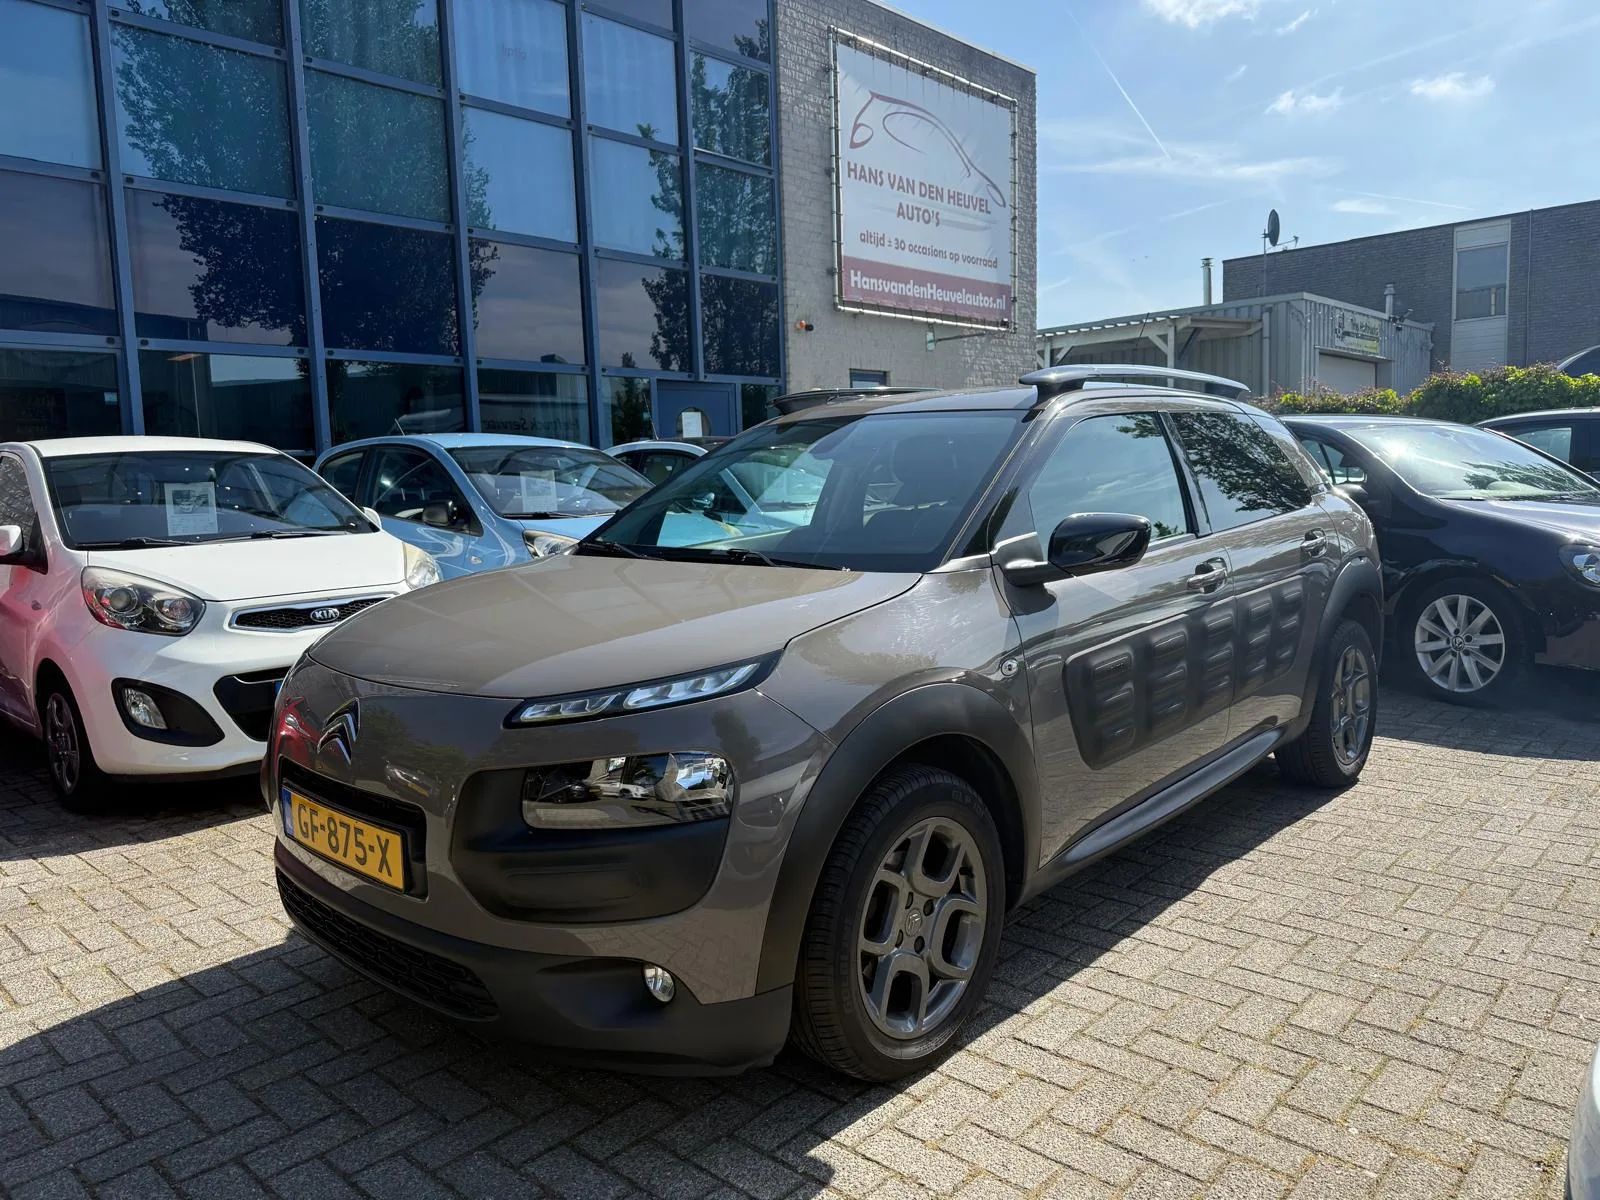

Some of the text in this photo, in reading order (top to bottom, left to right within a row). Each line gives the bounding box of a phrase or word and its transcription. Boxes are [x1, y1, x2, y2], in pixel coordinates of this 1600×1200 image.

[847, 160, 992, 215] HANS VAN DEN HEUVEL
[896, 201, 941, 227] AUTO'S
[860, 230, 886, 248] altijd
[894, 237, 906, 252] 30
[908, 241, 947, 260] occasions
[949, 250, 960, 264] op
[961, 252, 998, 269] voorraad
[850, 270, 1006, 311] HansvandenHeuvelautos.nl
[315, 609, 336, 619] KIA
[297, 803, 393, 878] GF-875-X
